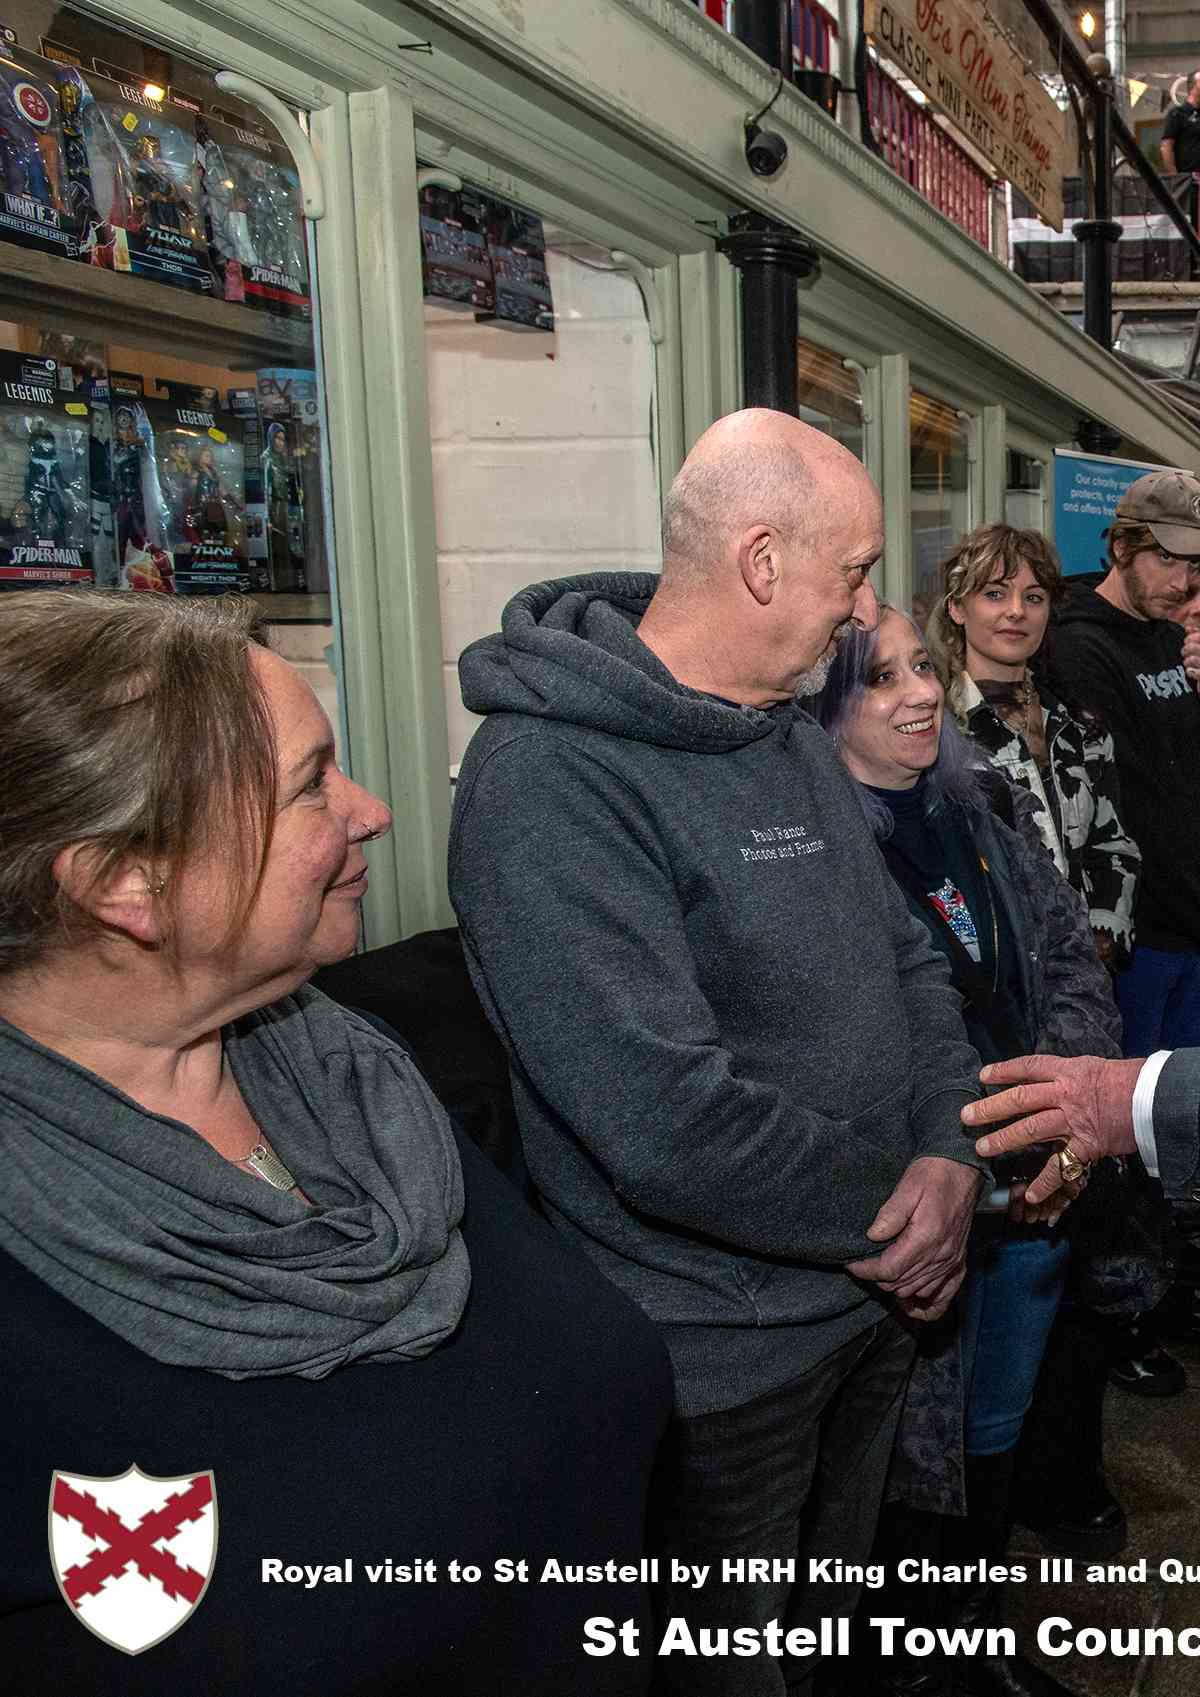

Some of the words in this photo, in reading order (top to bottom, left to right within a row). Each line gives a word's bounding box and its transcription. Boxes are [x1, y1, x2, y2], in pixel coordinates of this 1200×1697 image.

[880, 6, 932, 88] CLASSIC
[937, 69, 961, 120] MINI
[965, 99, 994, 156] PARTS
[7, 193, 35, 220] WHAT
[4, 381, 54, 405] LEGENDS
[176, 408, 216, 428] LEGENDS
[1074, 472, 1091, 486] Our
[9, 546, 83, 568] SPIDER-MAN
[751, 827, 777, 843] Paul
[740, 846, 778, 861] Photos
[778, 844, 795, 859] and
